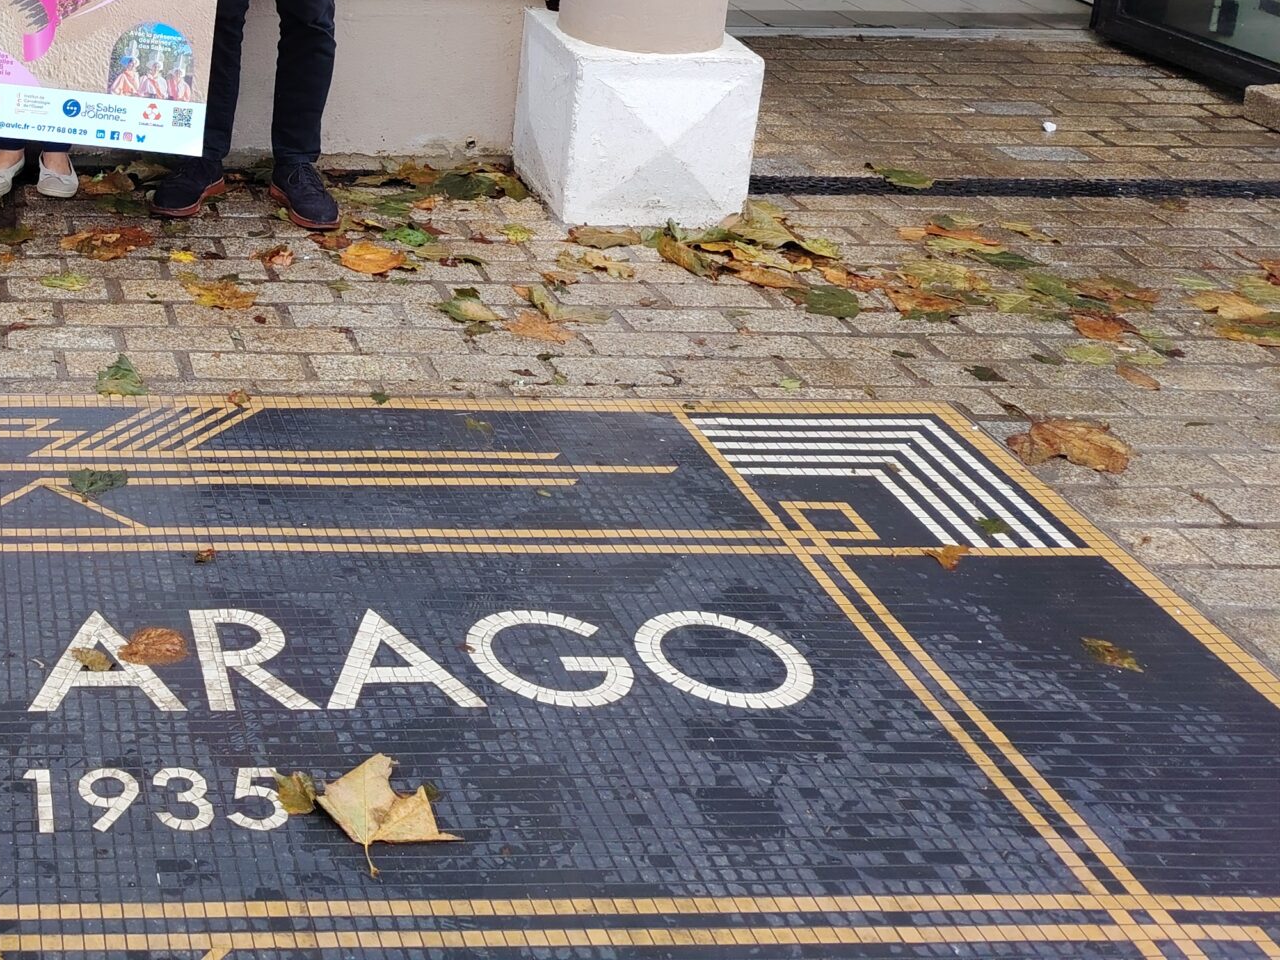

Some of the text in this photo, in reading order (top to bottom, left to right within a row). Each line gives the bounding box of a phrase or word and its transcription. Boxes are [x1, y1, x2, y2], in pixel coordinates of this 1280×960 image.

[81, 110, 120, 121] d'Olonne
[85, 101, 127, 115] les Sables
[27, 608, 814, 713] ARAGO
[24, 767, 291, 834] 1935
